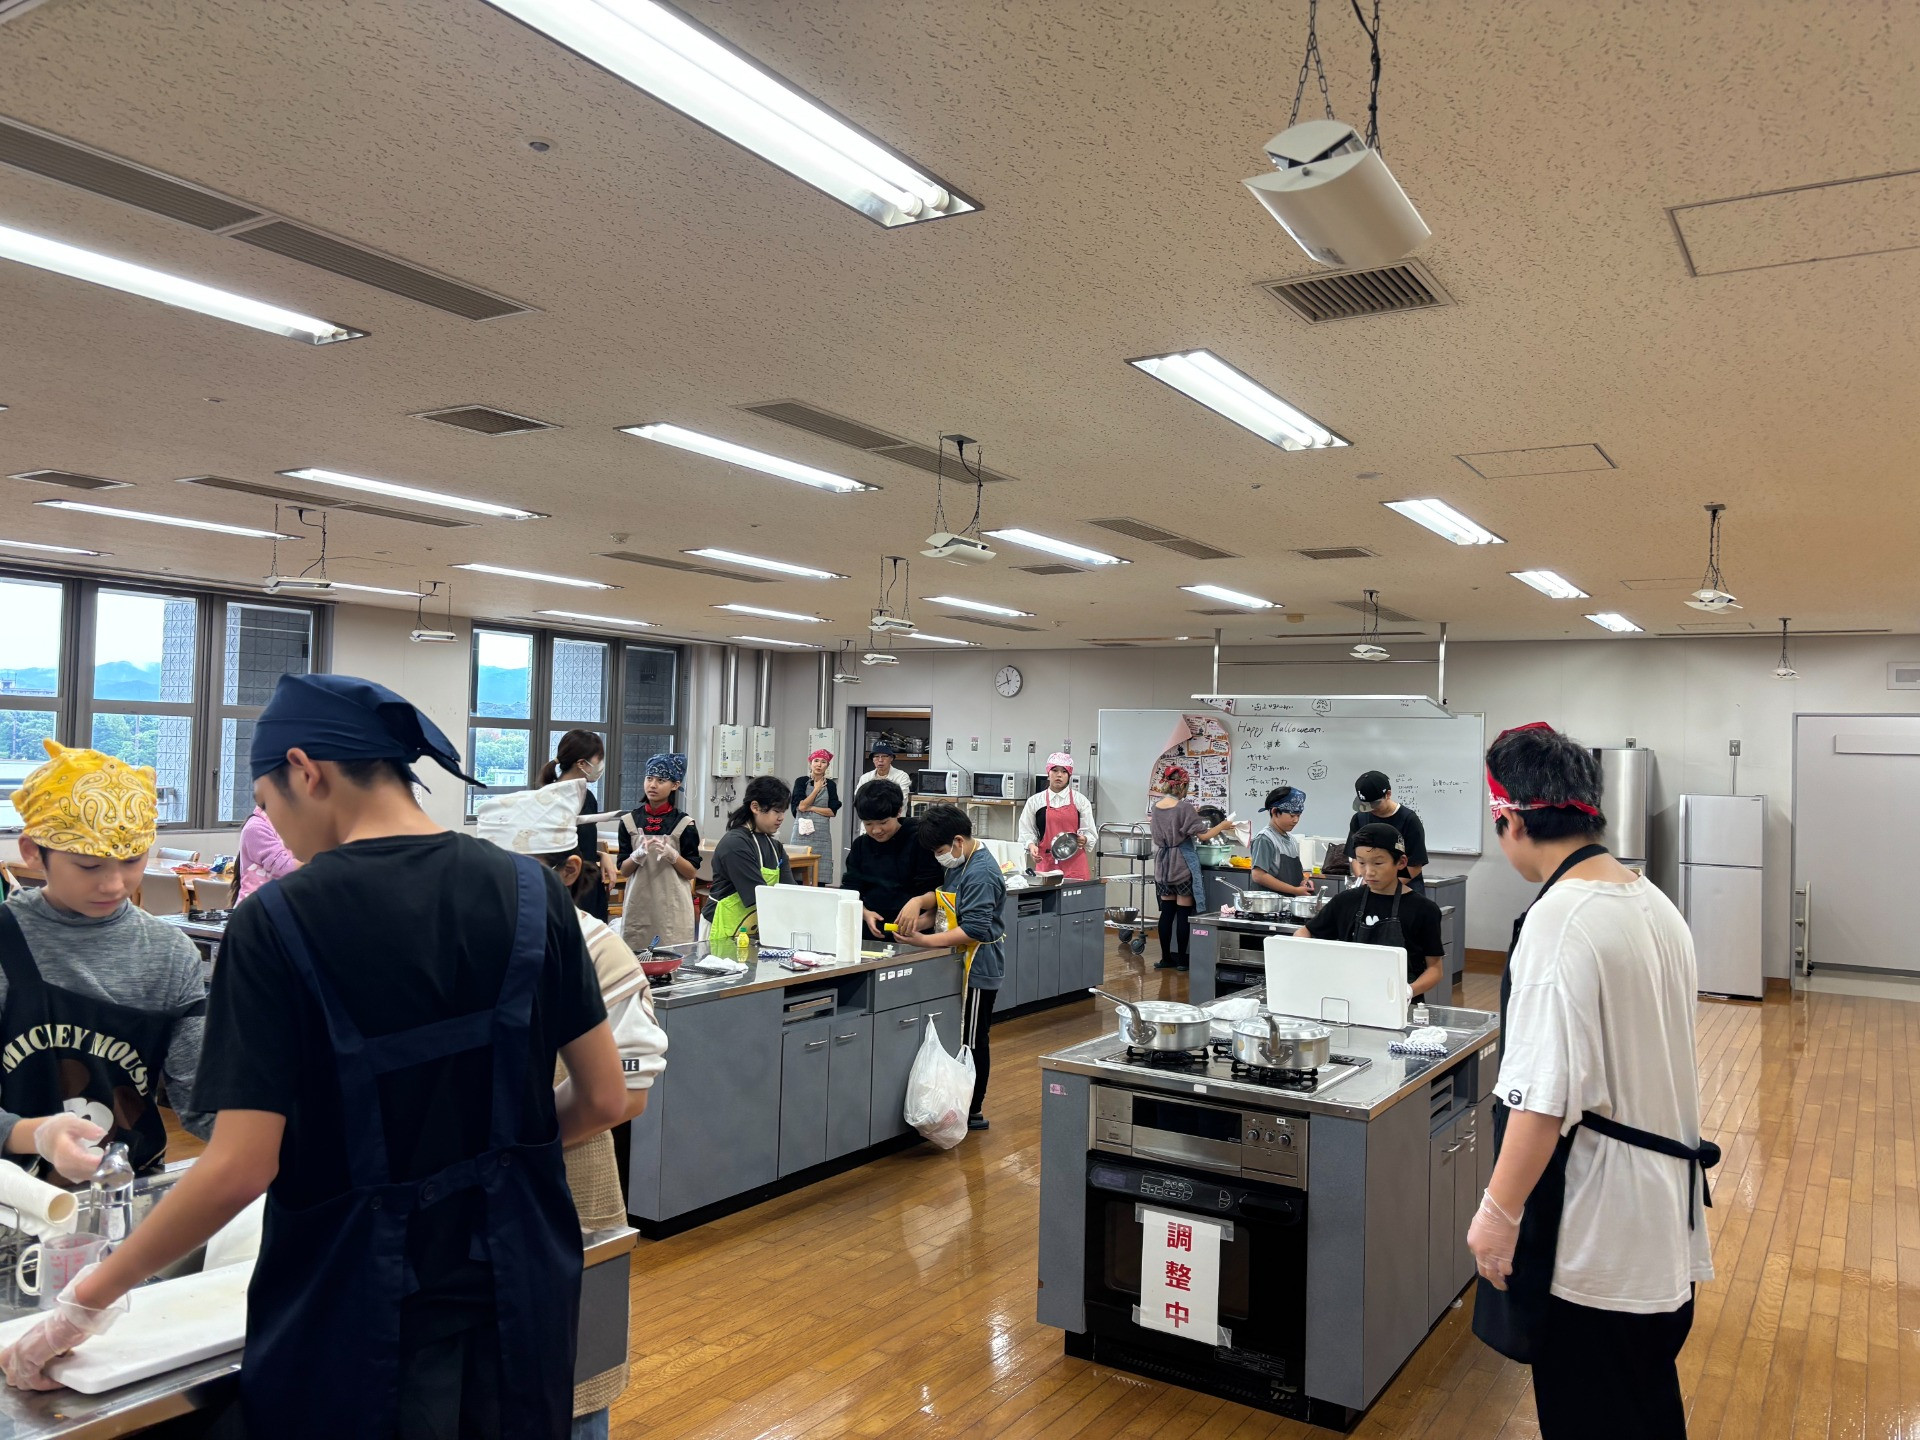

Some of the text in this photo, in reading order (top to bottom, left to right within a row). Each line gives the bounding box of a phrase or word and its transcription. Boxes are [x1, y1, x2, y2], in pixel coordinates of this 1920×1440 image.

[1237, 720, 1264, 738] Happy
[1165, 1221, 1192, 1328] 調整中
